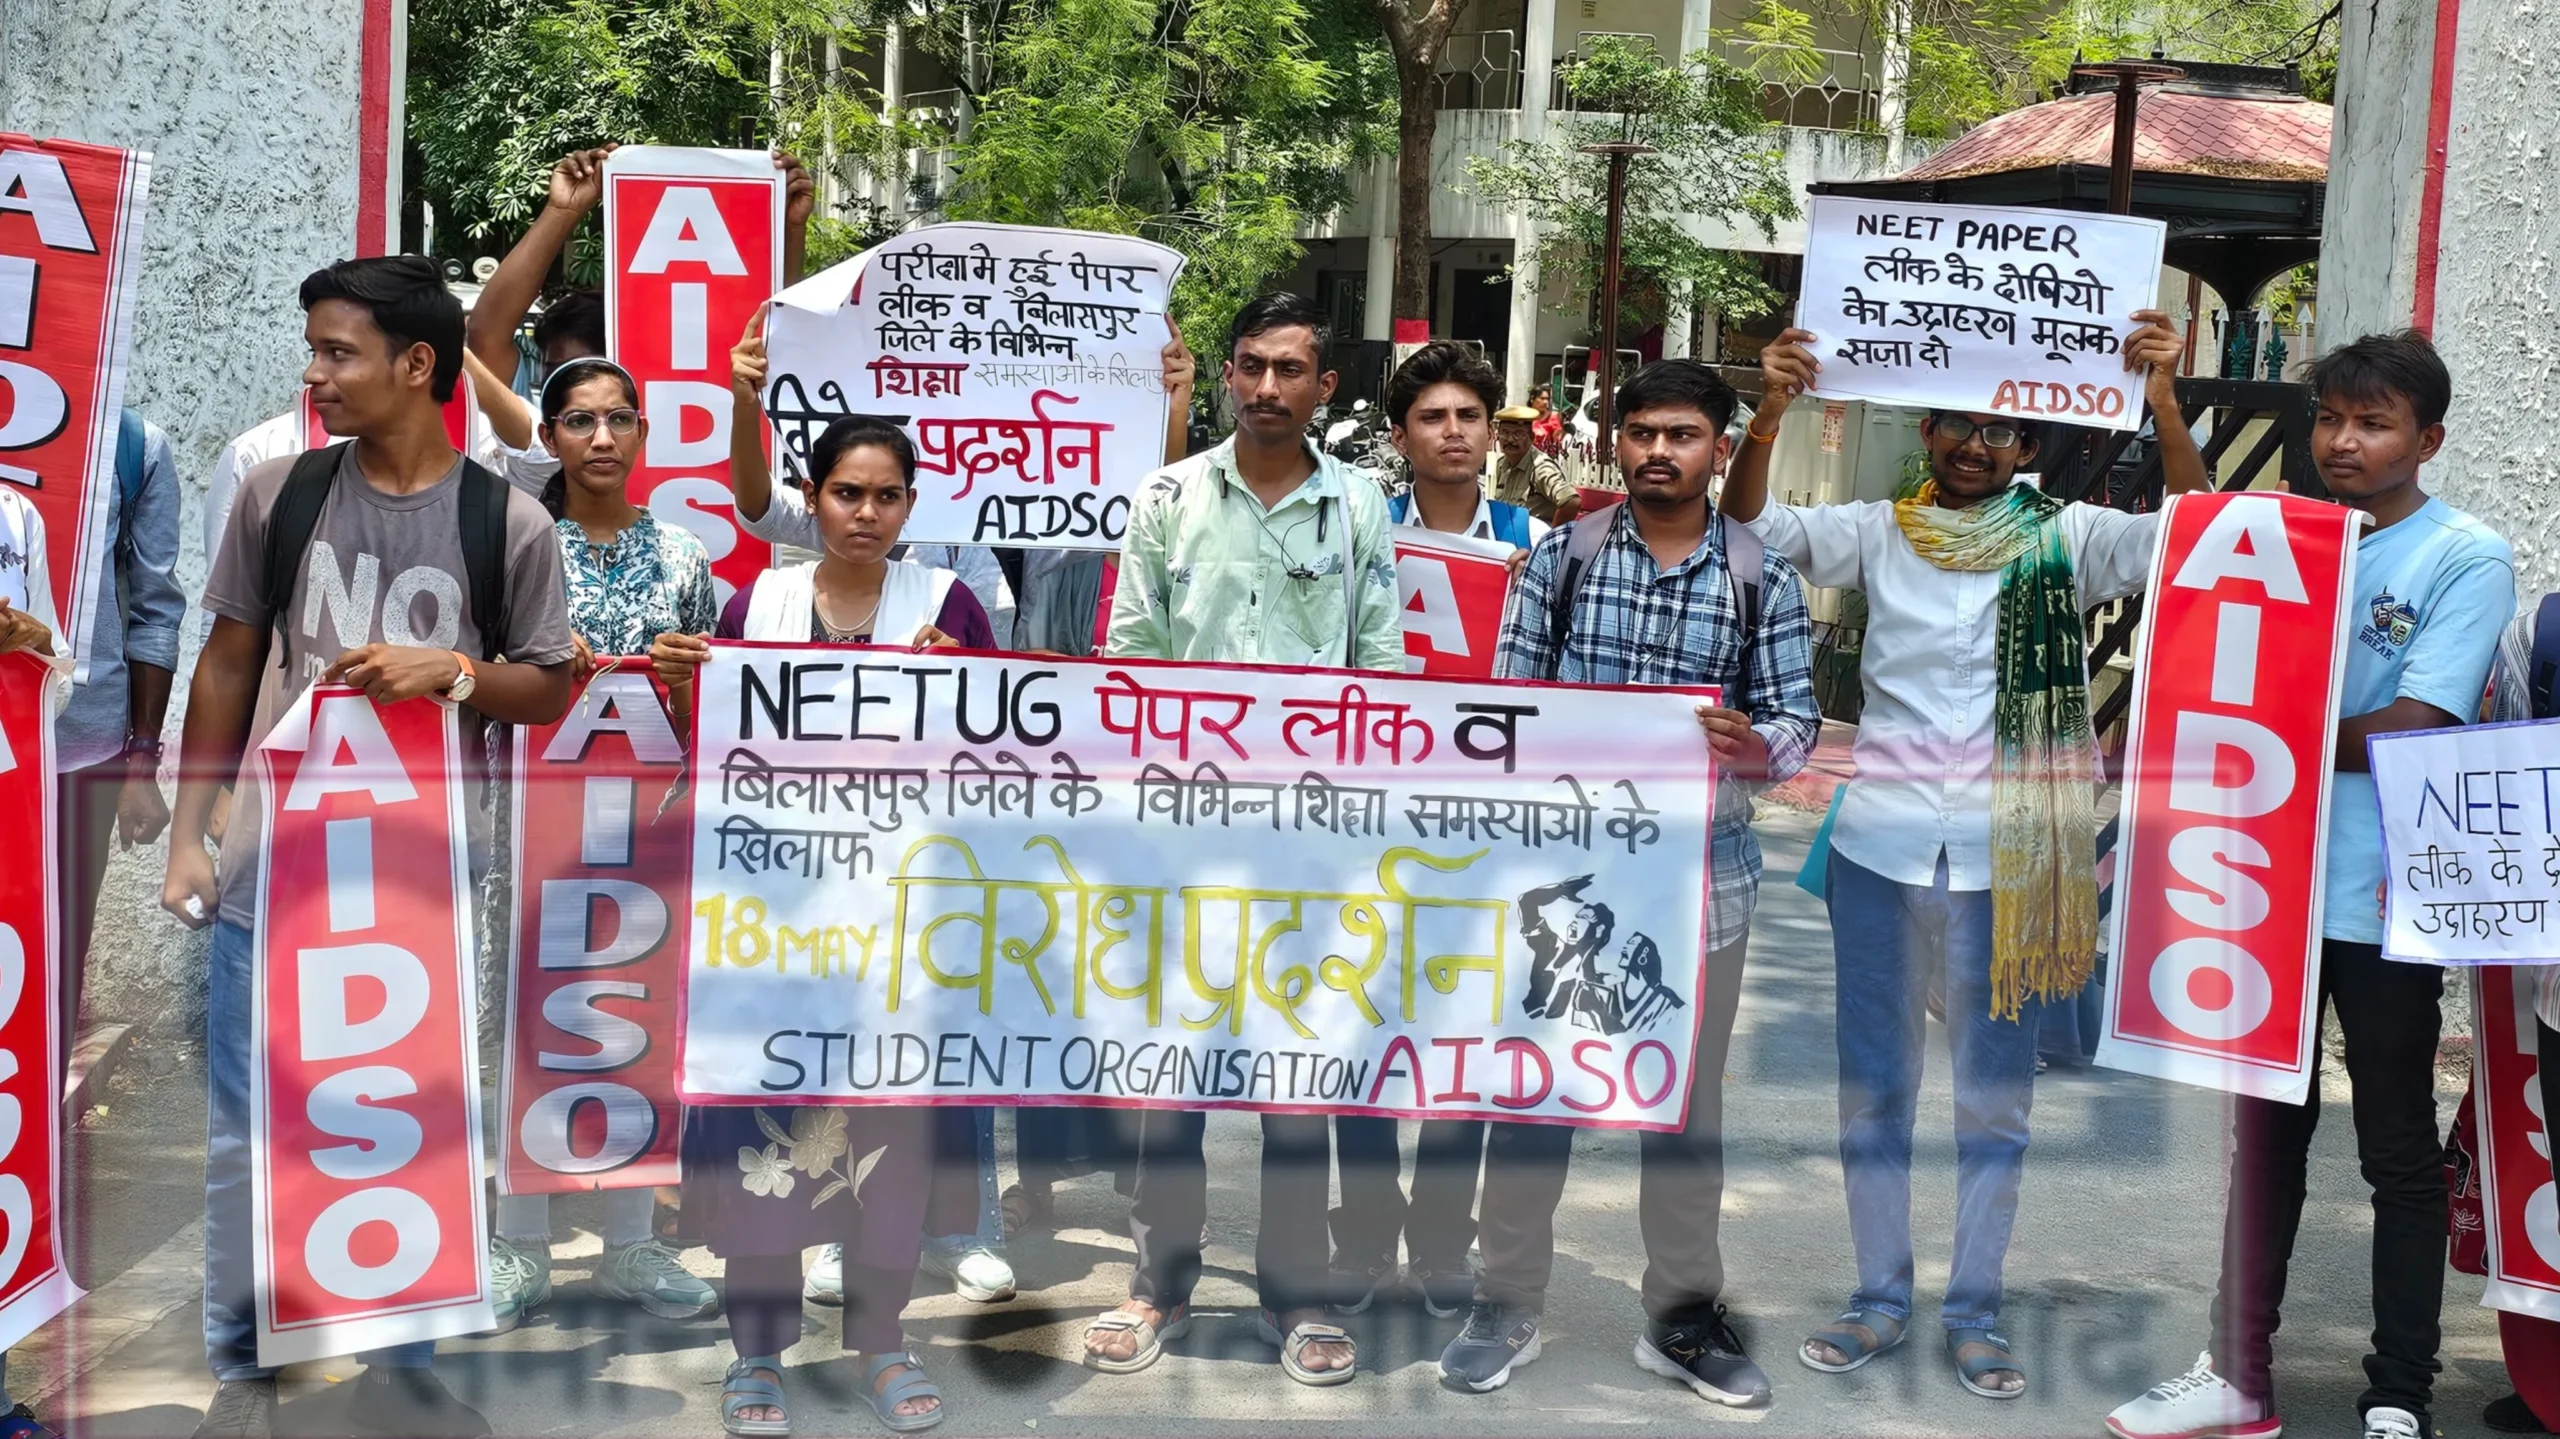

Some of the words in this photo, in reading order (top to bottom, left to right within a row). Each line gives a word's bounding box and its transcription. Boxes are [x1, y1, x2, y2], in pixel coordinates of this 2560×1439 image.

[1856, 214, 1945, 241] NEET
[1956, 220, 2080, 258] PAPER
[1069, 252, 1158, 293] पेपर
[1864, 247, 1941, 285] लीक
[1945, 252, 1984, 291] के
[879, 283, 954, 320] लीक
[962, 295, 991, 319] व
[1011, 292, 1140, 340] बिलासपुर
[874, 319, 944, 352] जिले
[949, 322, 982, 354] के
[985, 319, 1078, 361] विभिन्न
[1918, 334, 1952, 369] दो
[2031, 317, 2120, 363] मूलक
[865, 355, 970, 398] शिक्षा
[1088, 355, 1105, 383] के
[1990, 379, 2125, 418] AIDSO
[914, 389, 1115, 500] प्रदर्शन
[972, 492, 1130, 542] AIDSO
[303, 540, 462, 650] NO
[2359, 630, 2396, 661] BREAK
[1094, 670, 1257, 761] पेपर
[1280, 683, 1434, 766] लीक
[1453, 702, 1540, 774] व
[2148, 494, 2310, 1041] AIDSO
[719, 747, 931, 832] बिलासपुर
[938, 751, 1041, 819] जिले
[1049, 751, 1103, 818] के
[1134, 761, 1287, 832] विभिन्न
[1292, 770, 1389, 837] शिक्षा
[1404, 773, 1602, 851] समस्याओं
[1604, 779, 1662, 855] के
[714, 814, 873, 880] खिलाफ
[2408, 845, 2472, 891] लीक
[2488, 839, 2522, 887] के
[520, 674, 688, 1174] AIDSO
[693, 891, 771, 970] 18
[775, 923, 879, 982] MAY
[283, 695, 441, 1300] AIDSO
[760, 1029, 1052, 1091] STUDENT
[1059, 1035, 1369, 1102] ORGANISATION
[1368, 1035, 1677, 1114] AIDSO
